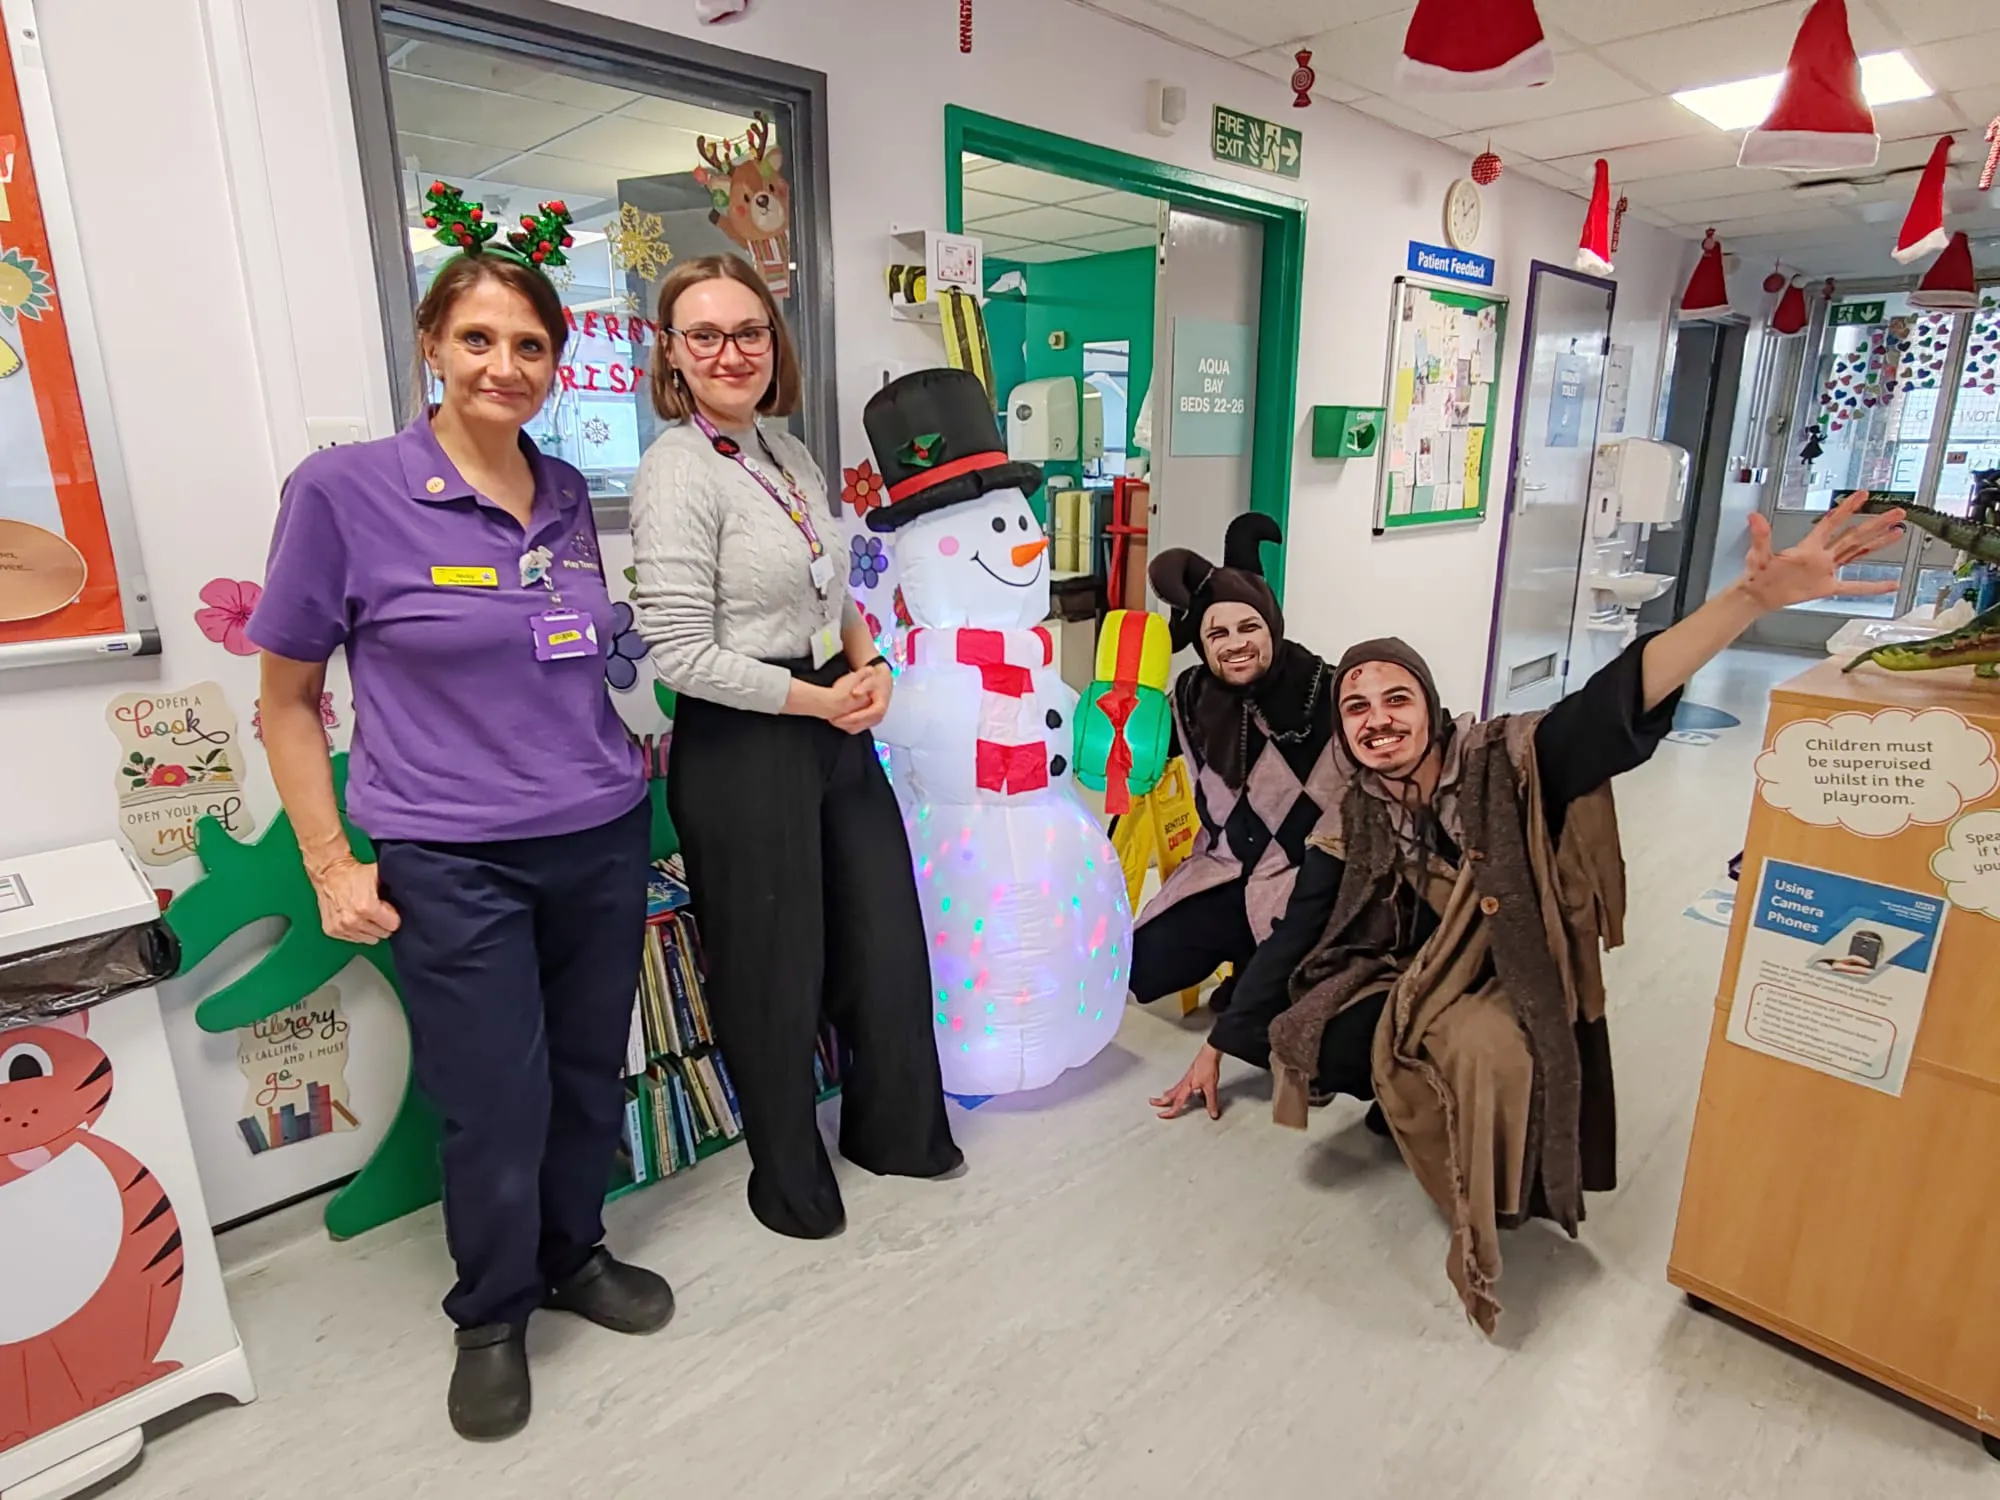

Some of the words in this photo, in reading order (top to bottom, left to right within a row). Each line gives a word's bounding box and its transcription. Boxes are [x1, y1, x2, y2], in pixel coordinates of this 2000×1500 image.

[1217, 112, 1245, 137] FIRE
[1216, 134, 1245, 159] EXIT
[1418, 250, 1451, 272] Patient
[1450, 257, 1486, 279] Feedback
[1198, 358, 1230, 375] AQUA
[1204, 378, 1223, 393] BAY
[1180, 396, 1210, 413] BEDS
[1213, 398, 1245, 414] 22-26
[156, 697, 188, 710] OPEN
[195, 696, 202, 706] A
[115, 699, 230, 745] book
[1805, 739, 1881, 752] Children
[1887, 741, 1933, 753] must
[1808, 756, 1828, 768] be
[1833, 758, 1932, 772] supervised
[1814, 773, 1867, 786] whilst
[1872, 774, 1889, 787] in
[1895, 775, 1925, 788] the
[1823, 790, 1916, 806] playroom.
[128, 812, 161, 826] OPEN
[167, 804, 200, 819] YOUR
[152, 797, 242, 857] mid
[1978, 845, 1989, 857] if
[1774, 879, 1815, 900] Using
[1771, 895, 1825, 918] Camera
[1767, 911, 1820, 933] Phones
[241, 1055, 250, 1064] IS
[255, 1042, 298, 1060] CALLING
[283, 1053, 305, 1066] AND
[309, 1050, 313, 1059] I
[317, 1042, 344, 1056] MUST
[255, 1068, 302, 1107] go
